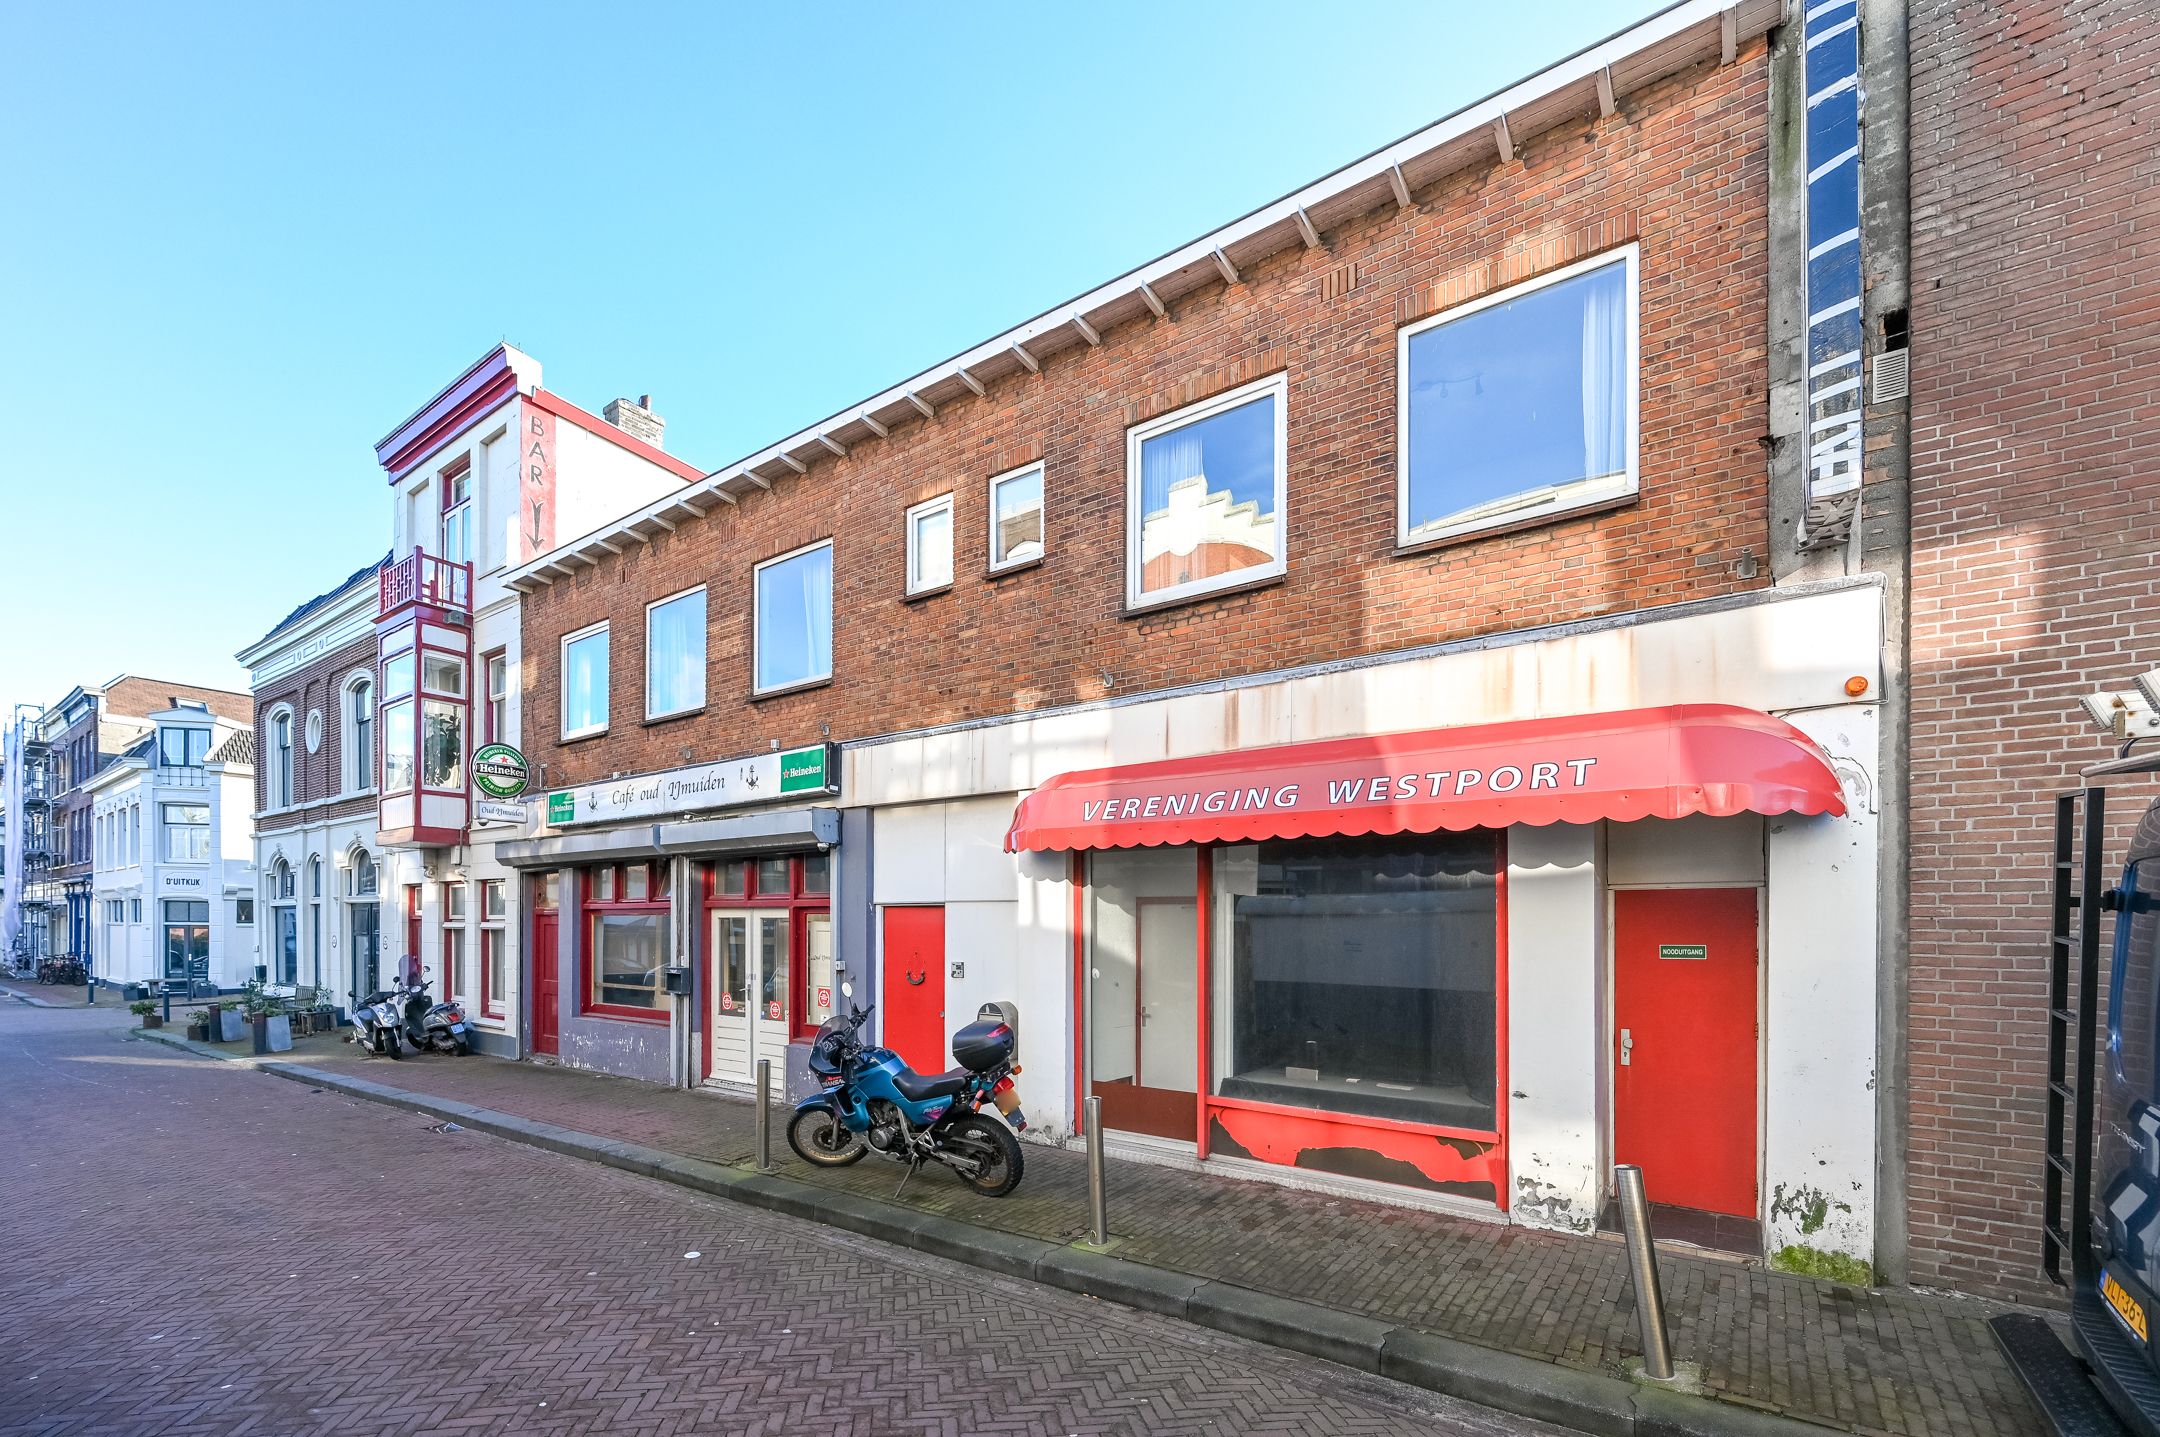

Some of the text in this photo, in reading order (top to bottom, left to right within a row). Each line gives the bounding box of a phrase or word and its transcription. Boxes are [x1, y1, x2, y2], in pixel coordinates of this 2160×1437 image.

[528, 415, 546, 486] BAR
[479, 764, 526, 777] Heineken
[789, 763, 822, 779] Heineken
[612, 784, 635, 811] Café
[640, 780, 662, 801] oud
[1082, 757, 1598, 822] VERENIGING WESTPORT
[481, 806, 495, 815] Oud
[554, 804, 574, 813] Heineken
